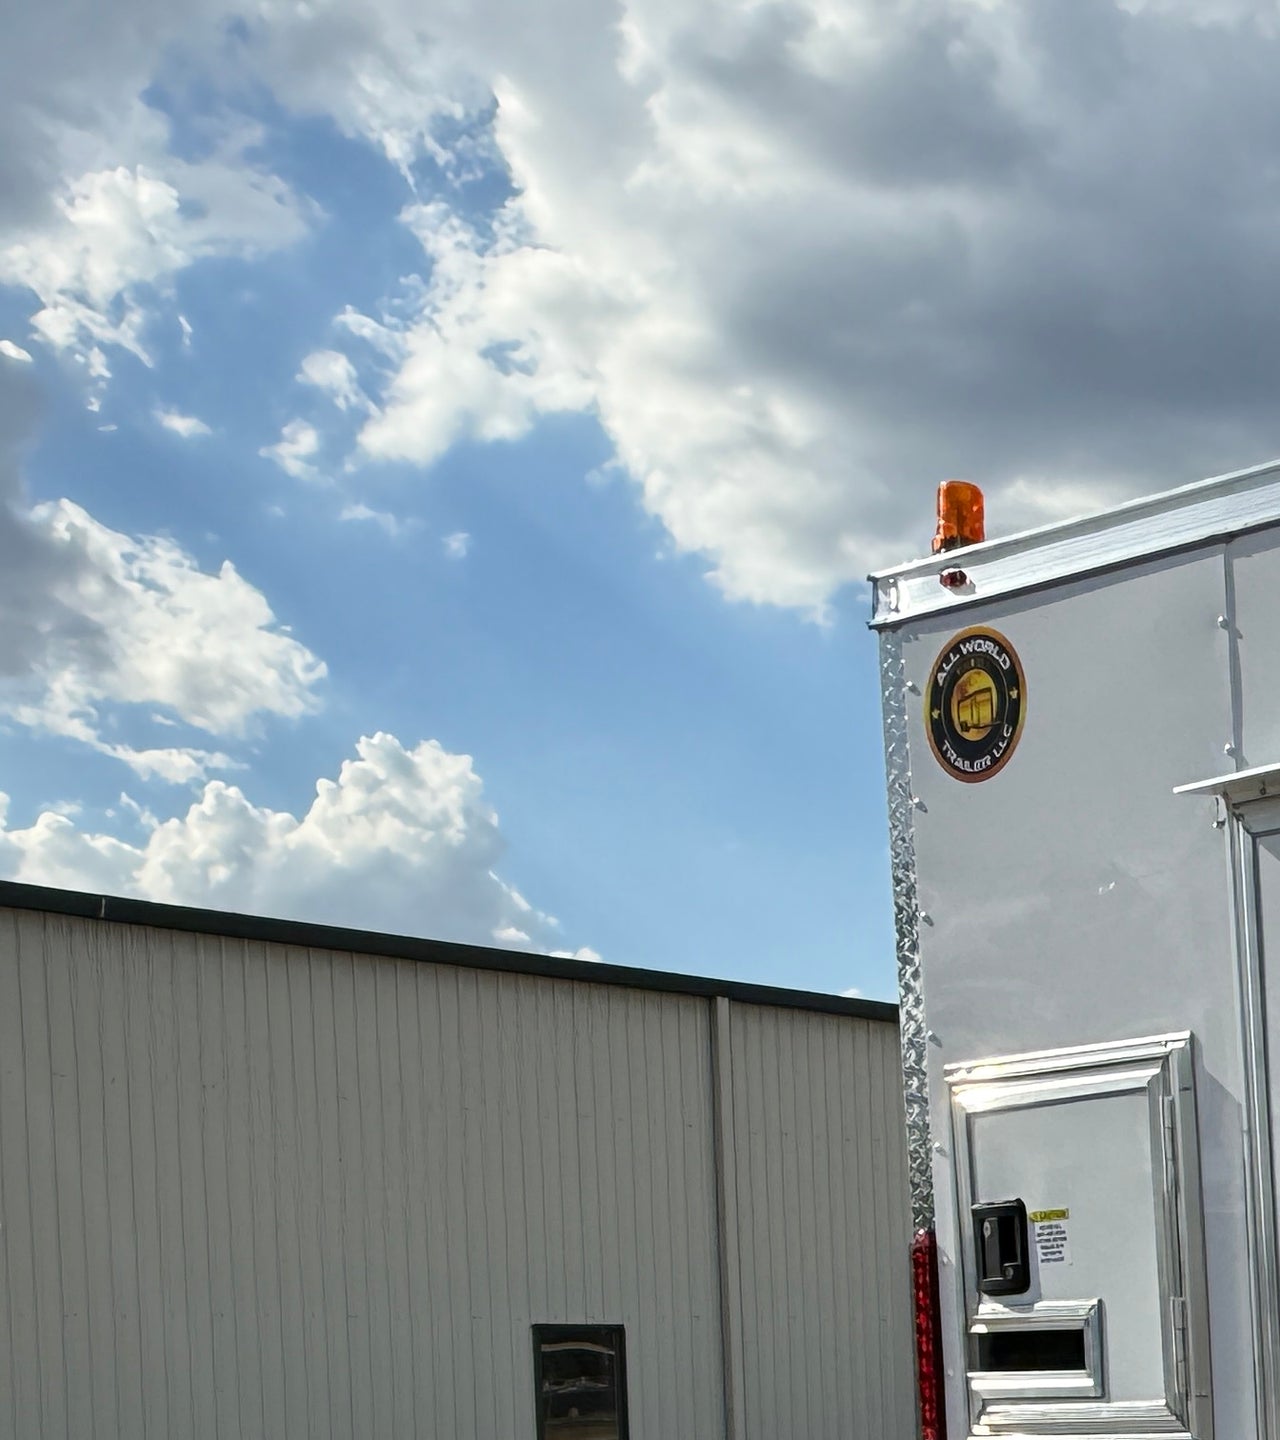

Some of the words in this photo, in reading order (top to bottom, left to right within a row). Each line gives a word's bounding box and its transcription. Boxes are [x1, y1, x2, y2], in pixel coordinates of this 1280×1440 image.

[936, 652, 960, 687] ALL
[959, 639, 1011, 671] WORLD
[993, 723, 1013, 757] LLC
